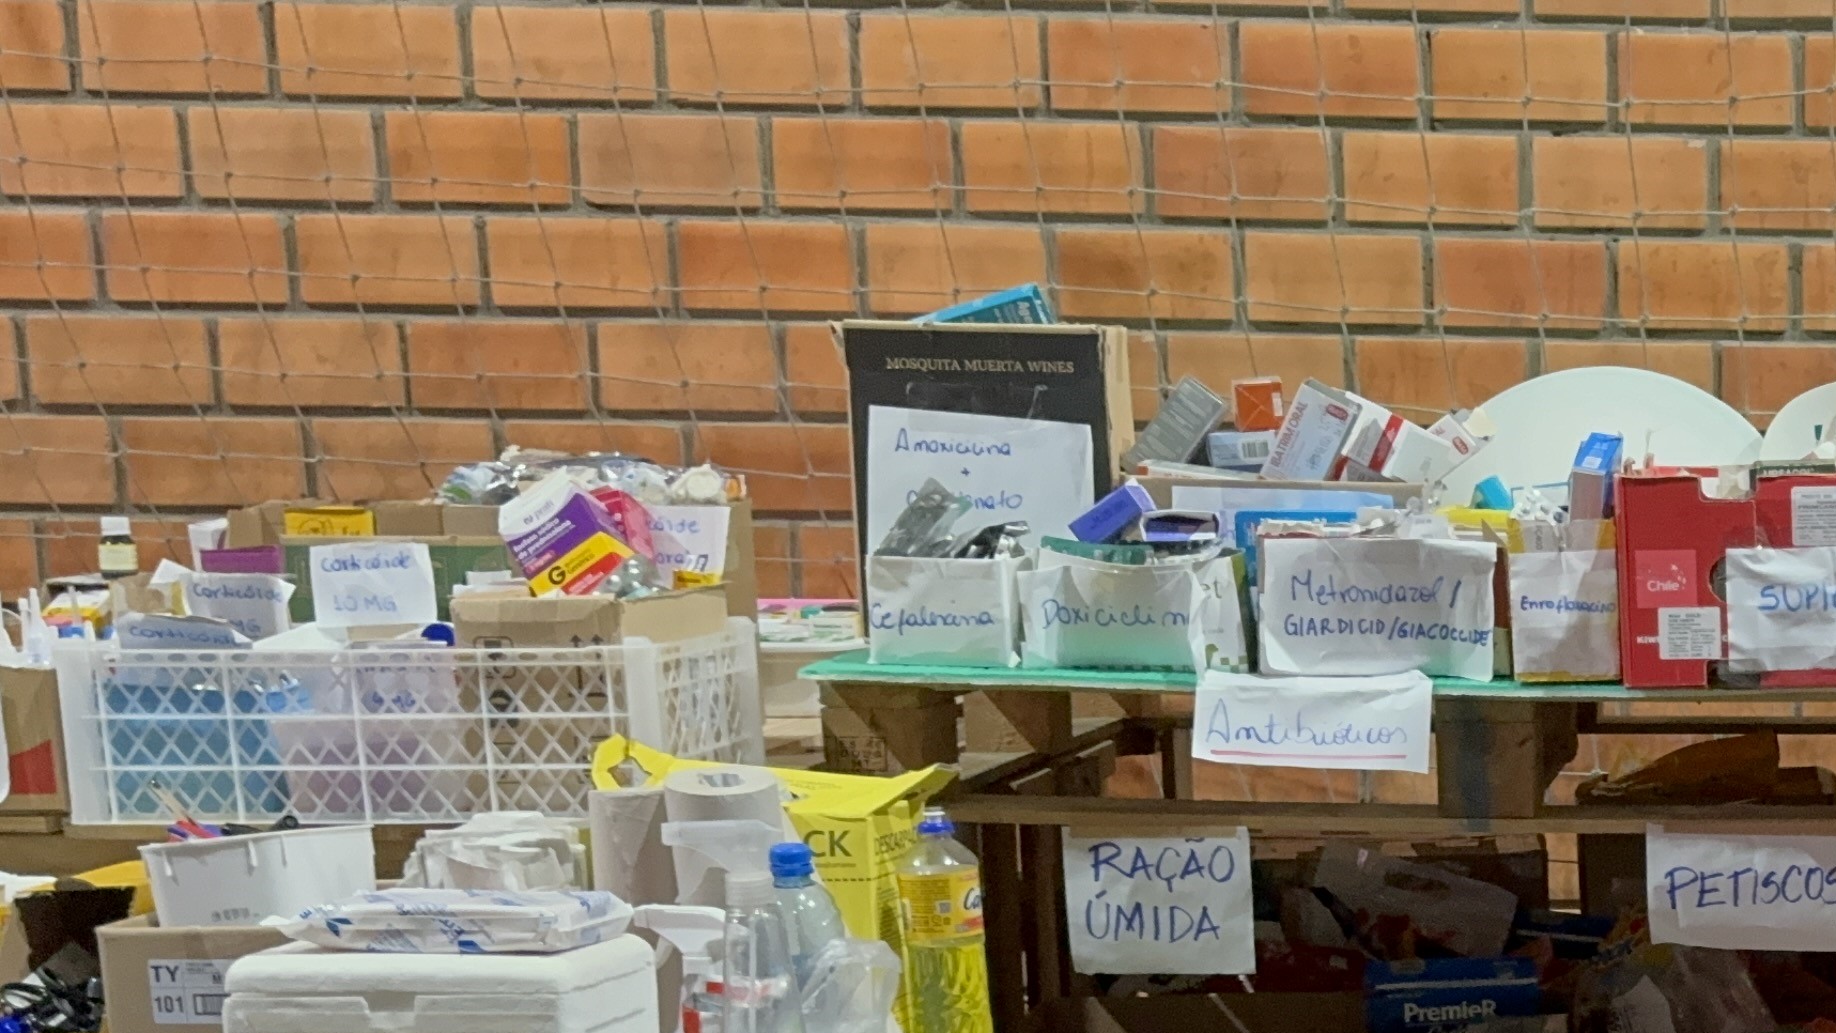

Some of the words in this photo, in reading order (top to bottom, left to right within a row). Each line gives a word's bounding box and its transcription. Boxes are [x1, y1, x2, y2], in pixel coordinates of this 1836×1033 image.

[886, 356, 961, 372] MOSQUITA
[964, 359, 1024, 372] MUERTA
[1028, 361, 1075, 374] WINES
[1290, 401, 1310, 430] ORAL
[548, 565, 567, 585] G
[1291, 568, 1444, 606] Metronidazol
[1647, 579, 1680, 592] Chile
[1088, 837, 1235, 893] RAÇÃO
[1086, 889, 1221, 944] ÚMIDA
[150, 965, 180, 983] TY
[154, 996, 185, 1013] 101
